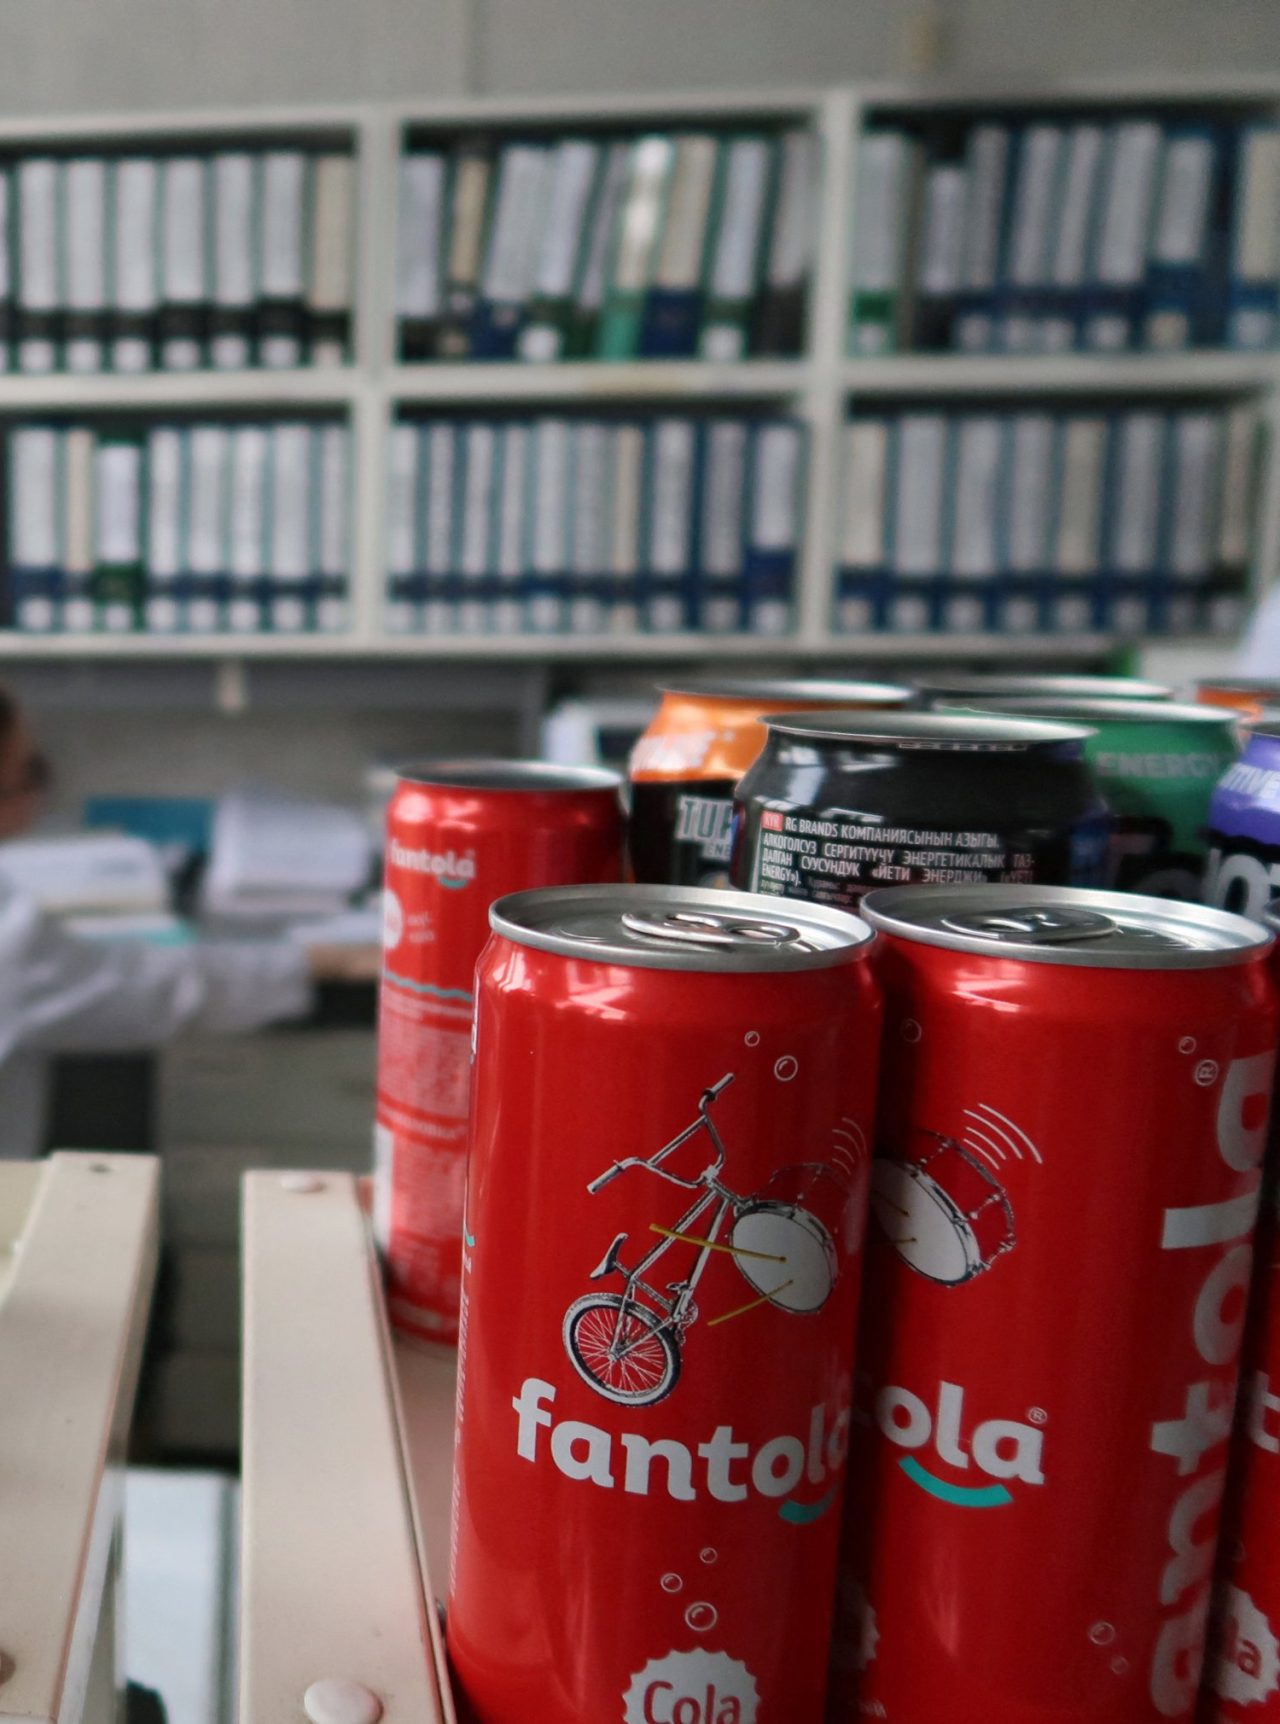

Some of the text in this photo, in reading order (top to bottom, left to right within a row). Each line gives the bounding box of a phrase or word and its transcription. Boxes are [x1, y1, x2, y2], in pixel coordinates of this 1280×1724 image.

[785, 816, 1000, 848] RG BRANDS КОМПАНИЯСЫНЫН АЗЫГЫ.
[389, 838, 476, 879] fantola
[763, 833, 817, 855] АЛКОГОЛСУЗ
[903, 850, 1005, 868] ЭНЕРГЕТИКАЛЫК
[801, 855, 860, 878] СУУСУНДУК
[643, 1680, 742, 1724] Cola
